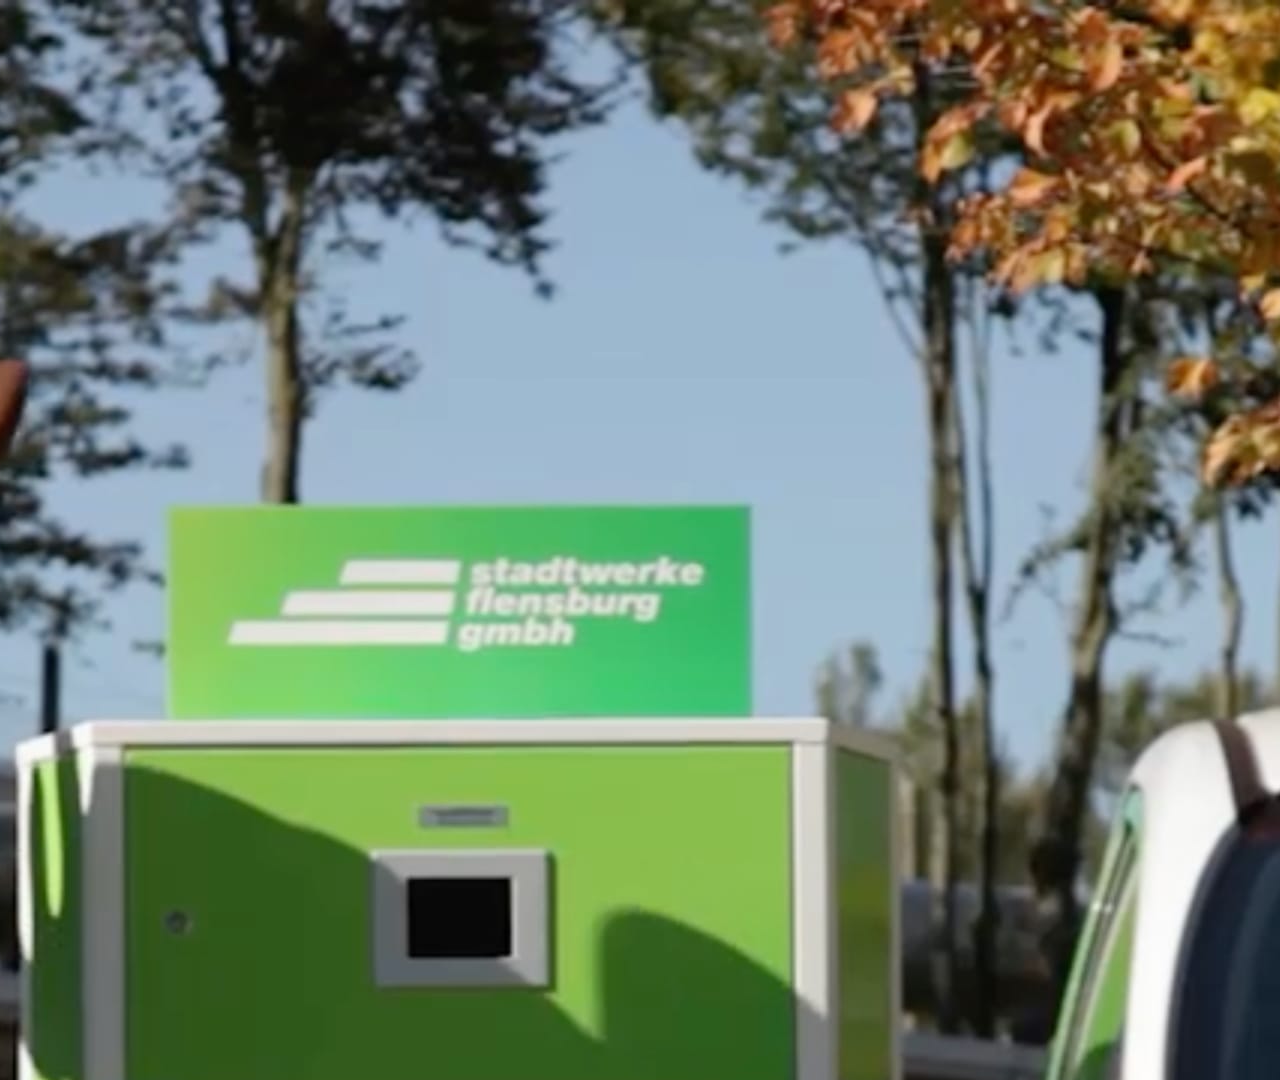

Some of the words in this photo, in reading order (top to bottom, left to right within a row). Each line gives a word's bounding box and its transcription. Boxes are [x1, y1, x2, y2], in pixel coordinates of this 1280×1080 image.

[470, 556, 705, 586] stadtwerke
[465, 588, 661, 621] flensburg
[457, 618, 575, 652] gmbh
